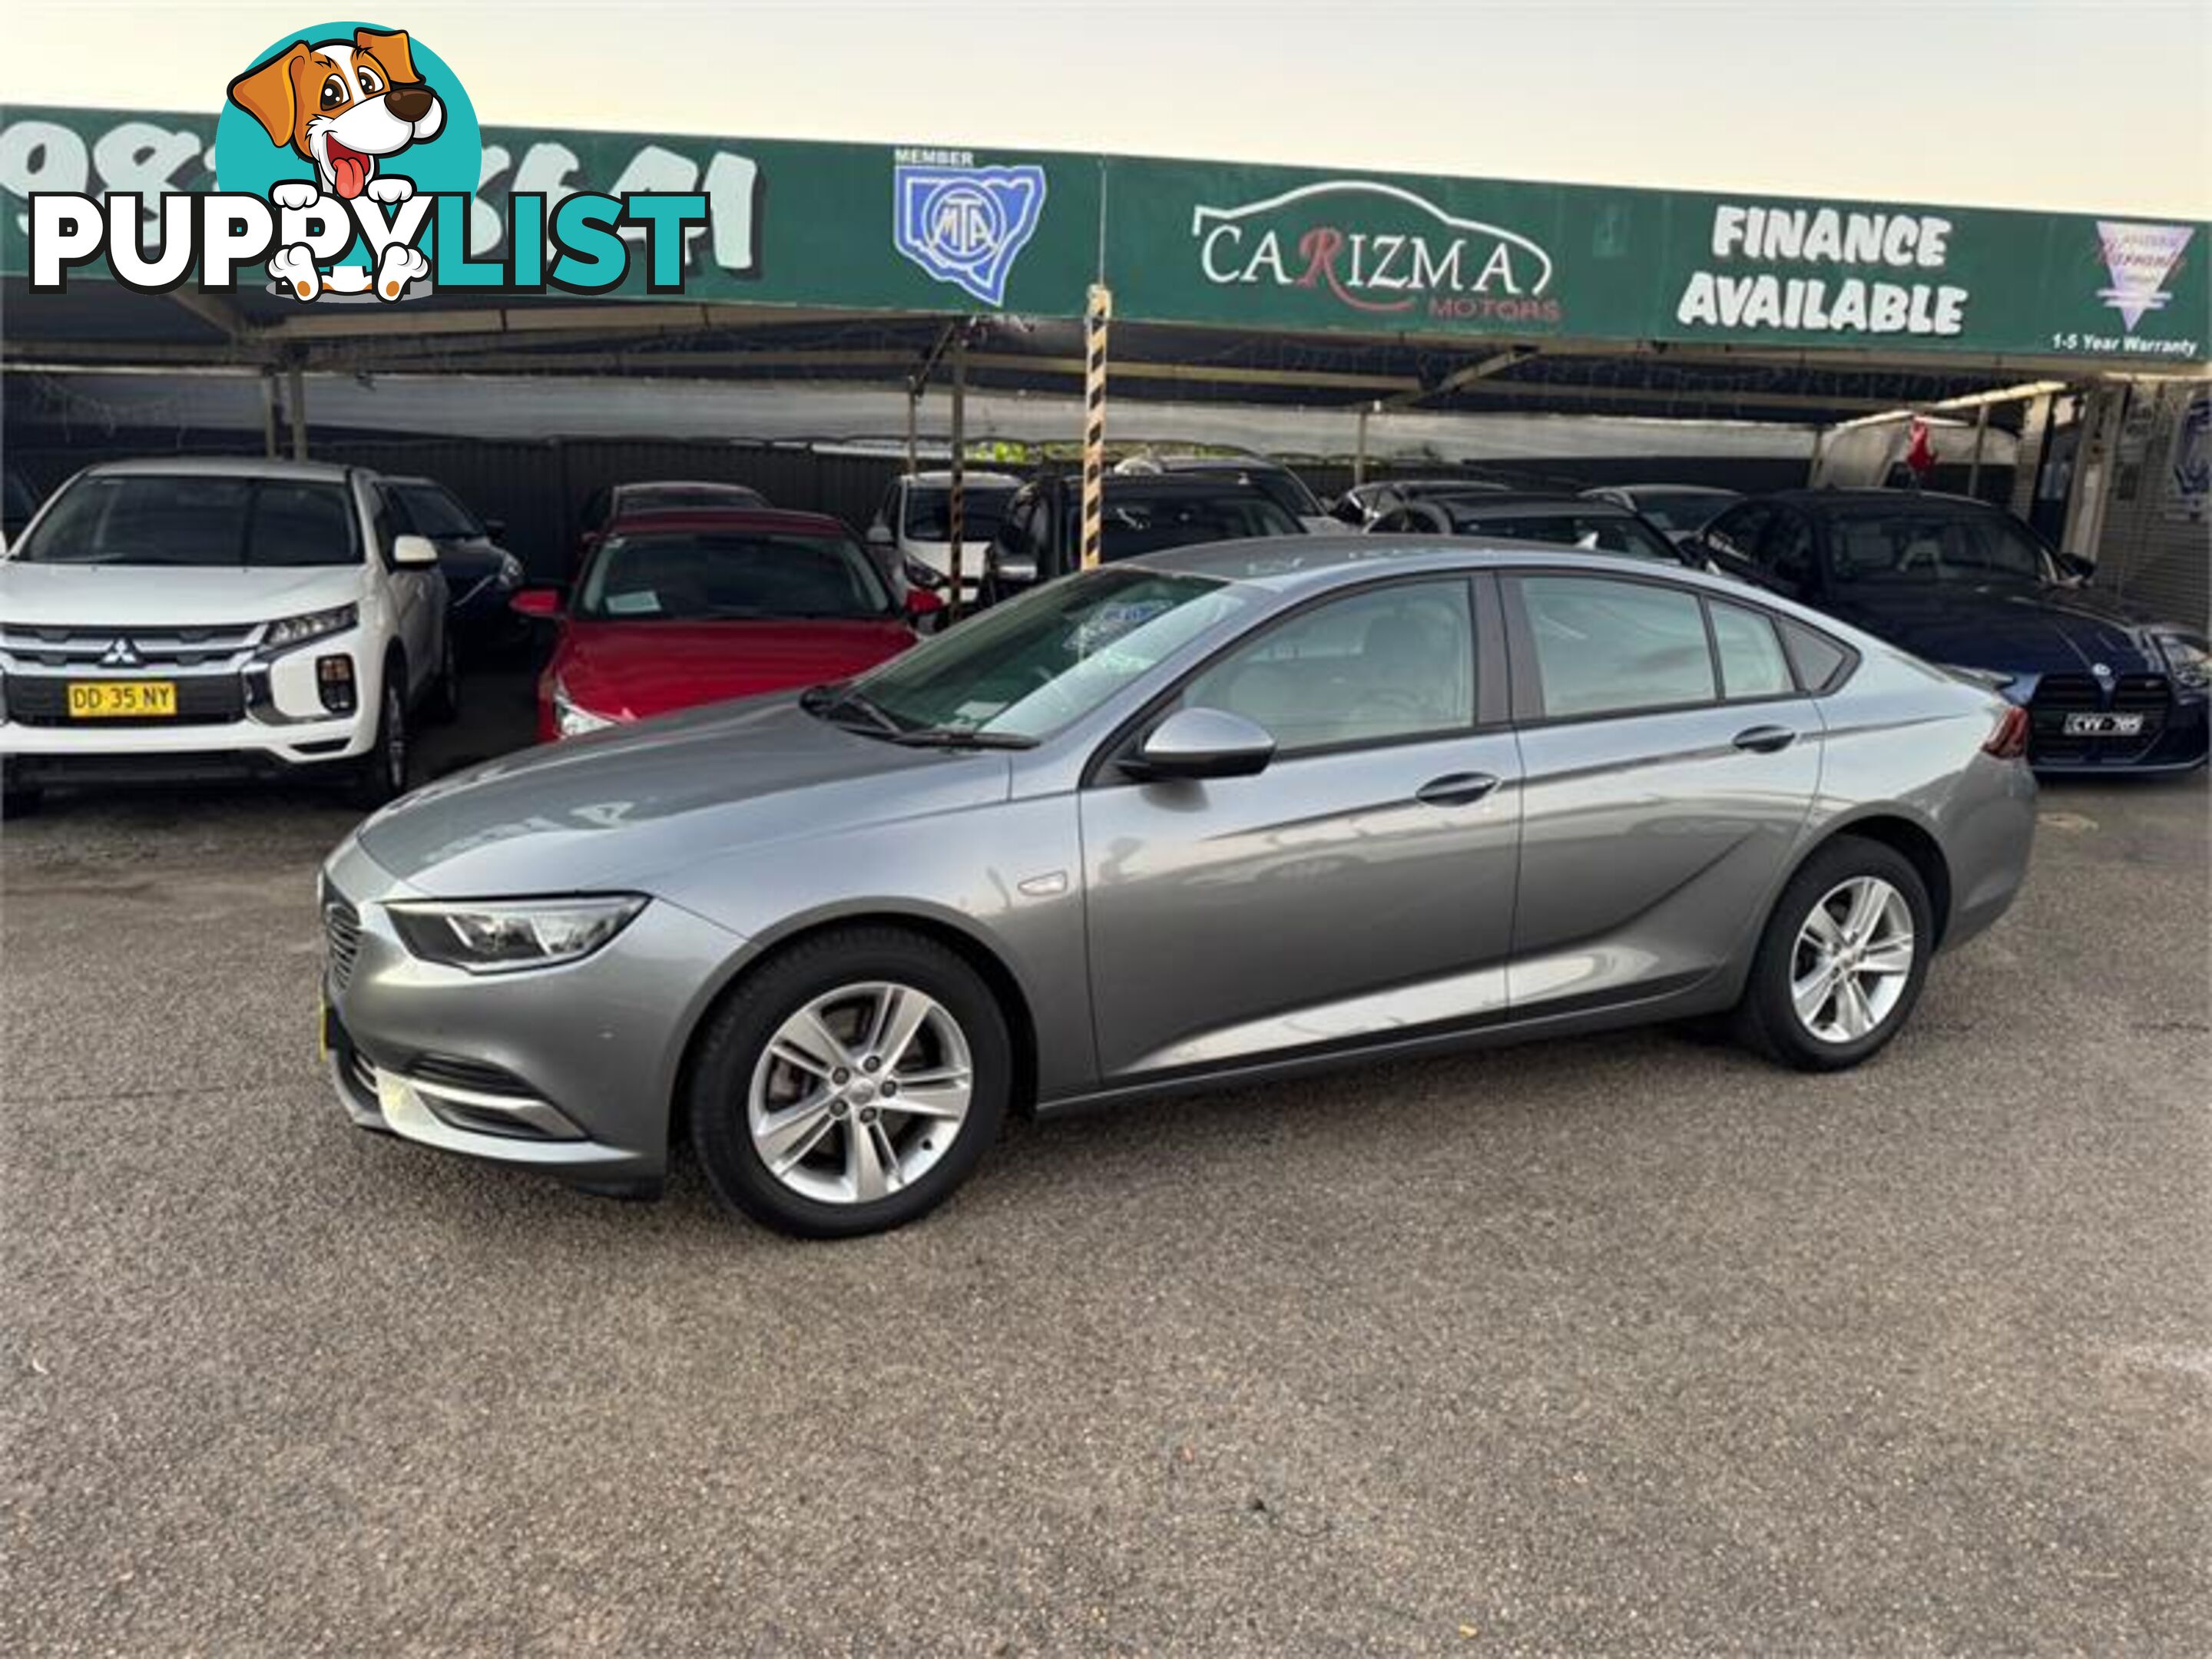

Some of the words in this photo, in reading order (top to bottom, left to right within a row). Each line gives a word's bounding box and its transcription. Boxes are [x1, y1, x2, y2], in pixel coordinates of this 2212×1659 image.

[895, 148, 974, 166] MEMBER
[928, 197, 998, 256] MTA
[1713, 206, 1952, 267] FINANCE
[1201, 224, 1522, 310] CARIZMA
[1429, 297, 1561, 322] MOTORS
[1677, 272, 1969, 334] AVAILABLE
[2083, 334, 2119, 350] Year
[2124, 336, 2197, 356] Warranty
[74, 688, 102, 708] DD
[110, 688, 136, 707] 35
[144, 687, 169, 707] NY
